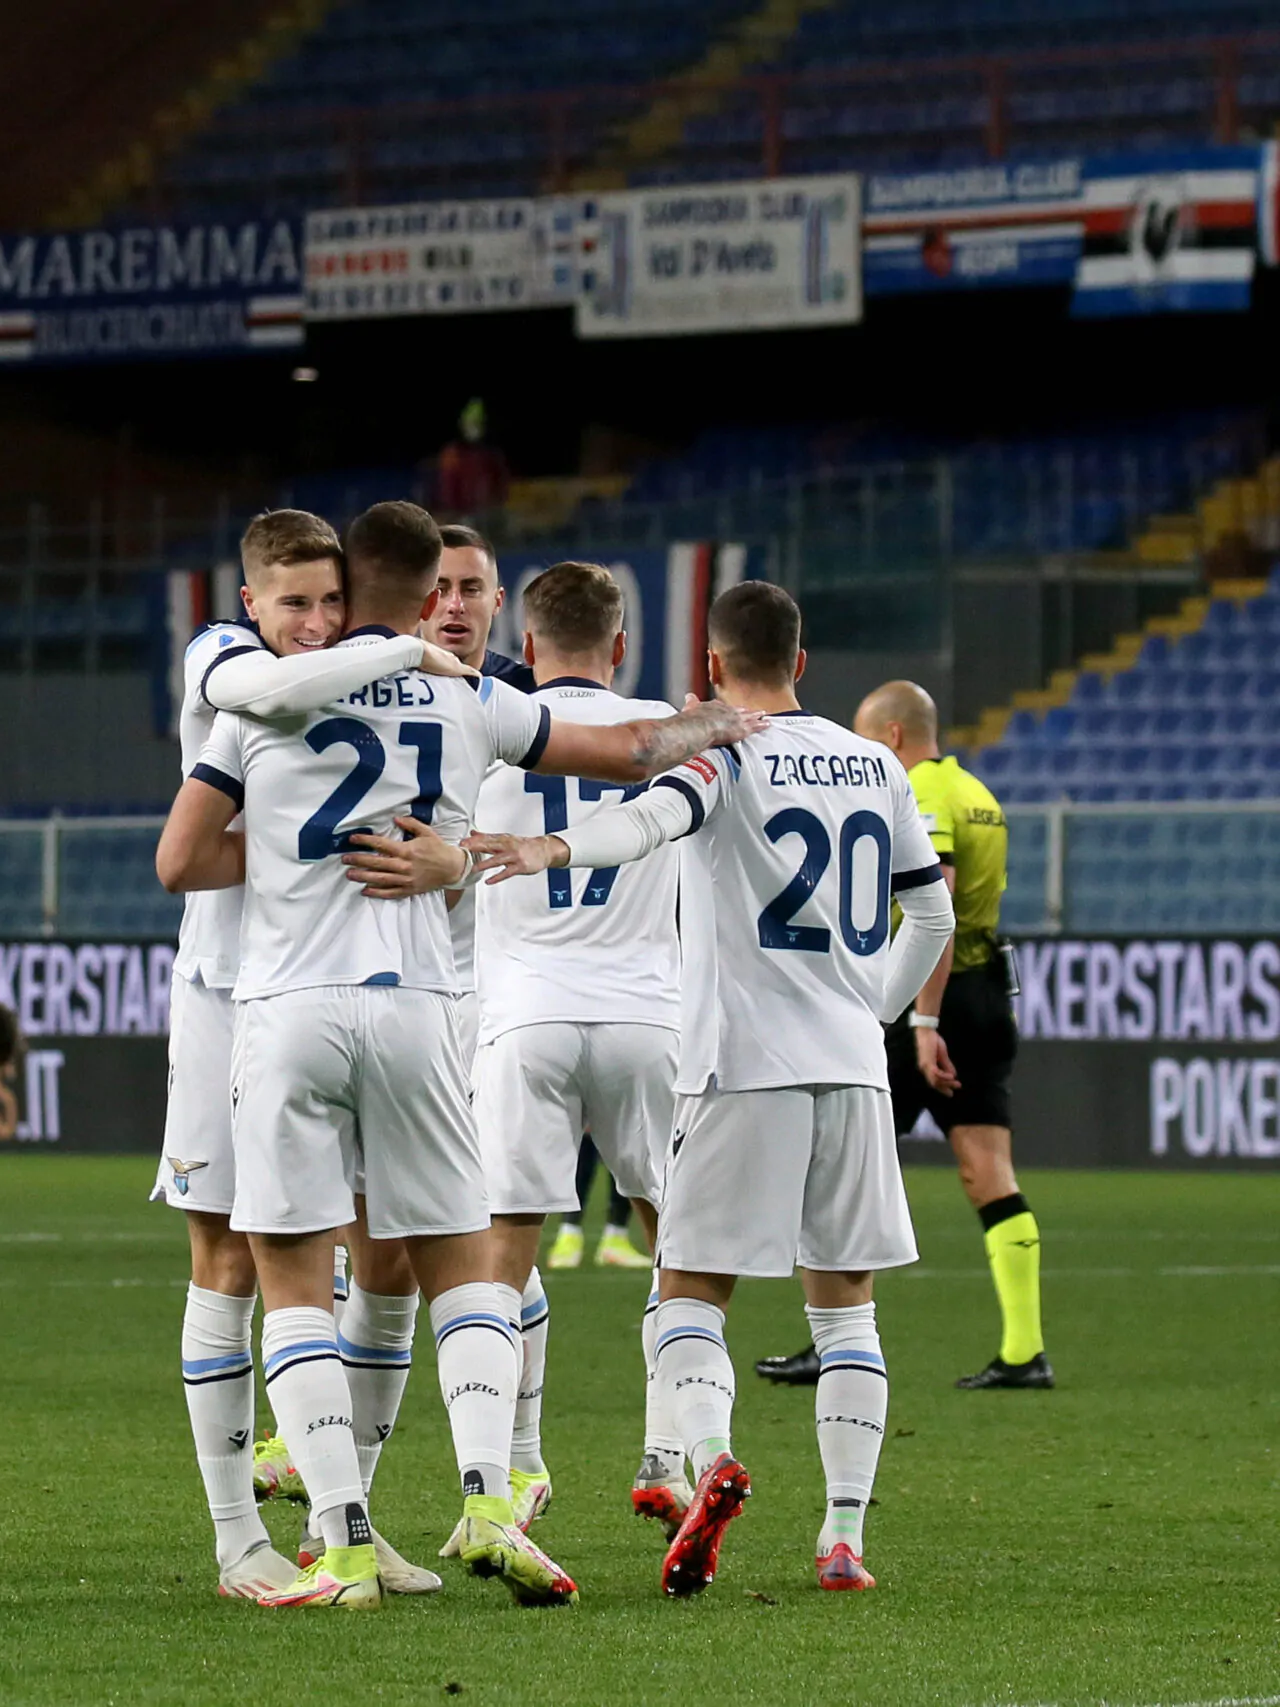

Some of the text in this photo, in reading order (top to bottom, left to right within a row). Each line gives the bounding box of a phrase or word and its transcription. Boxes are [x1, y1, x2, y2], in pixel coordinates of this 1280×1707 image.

[336, 676, 435, 708] RGEJ
[298, 717, 443, 861] 21
[764, 754, 888, 787] ZACCAGNI
[523, 771, 655, 909] 17
[757, 807, 892, 957] 20
[1011, 940, 1280, 1039] KERSTARS
